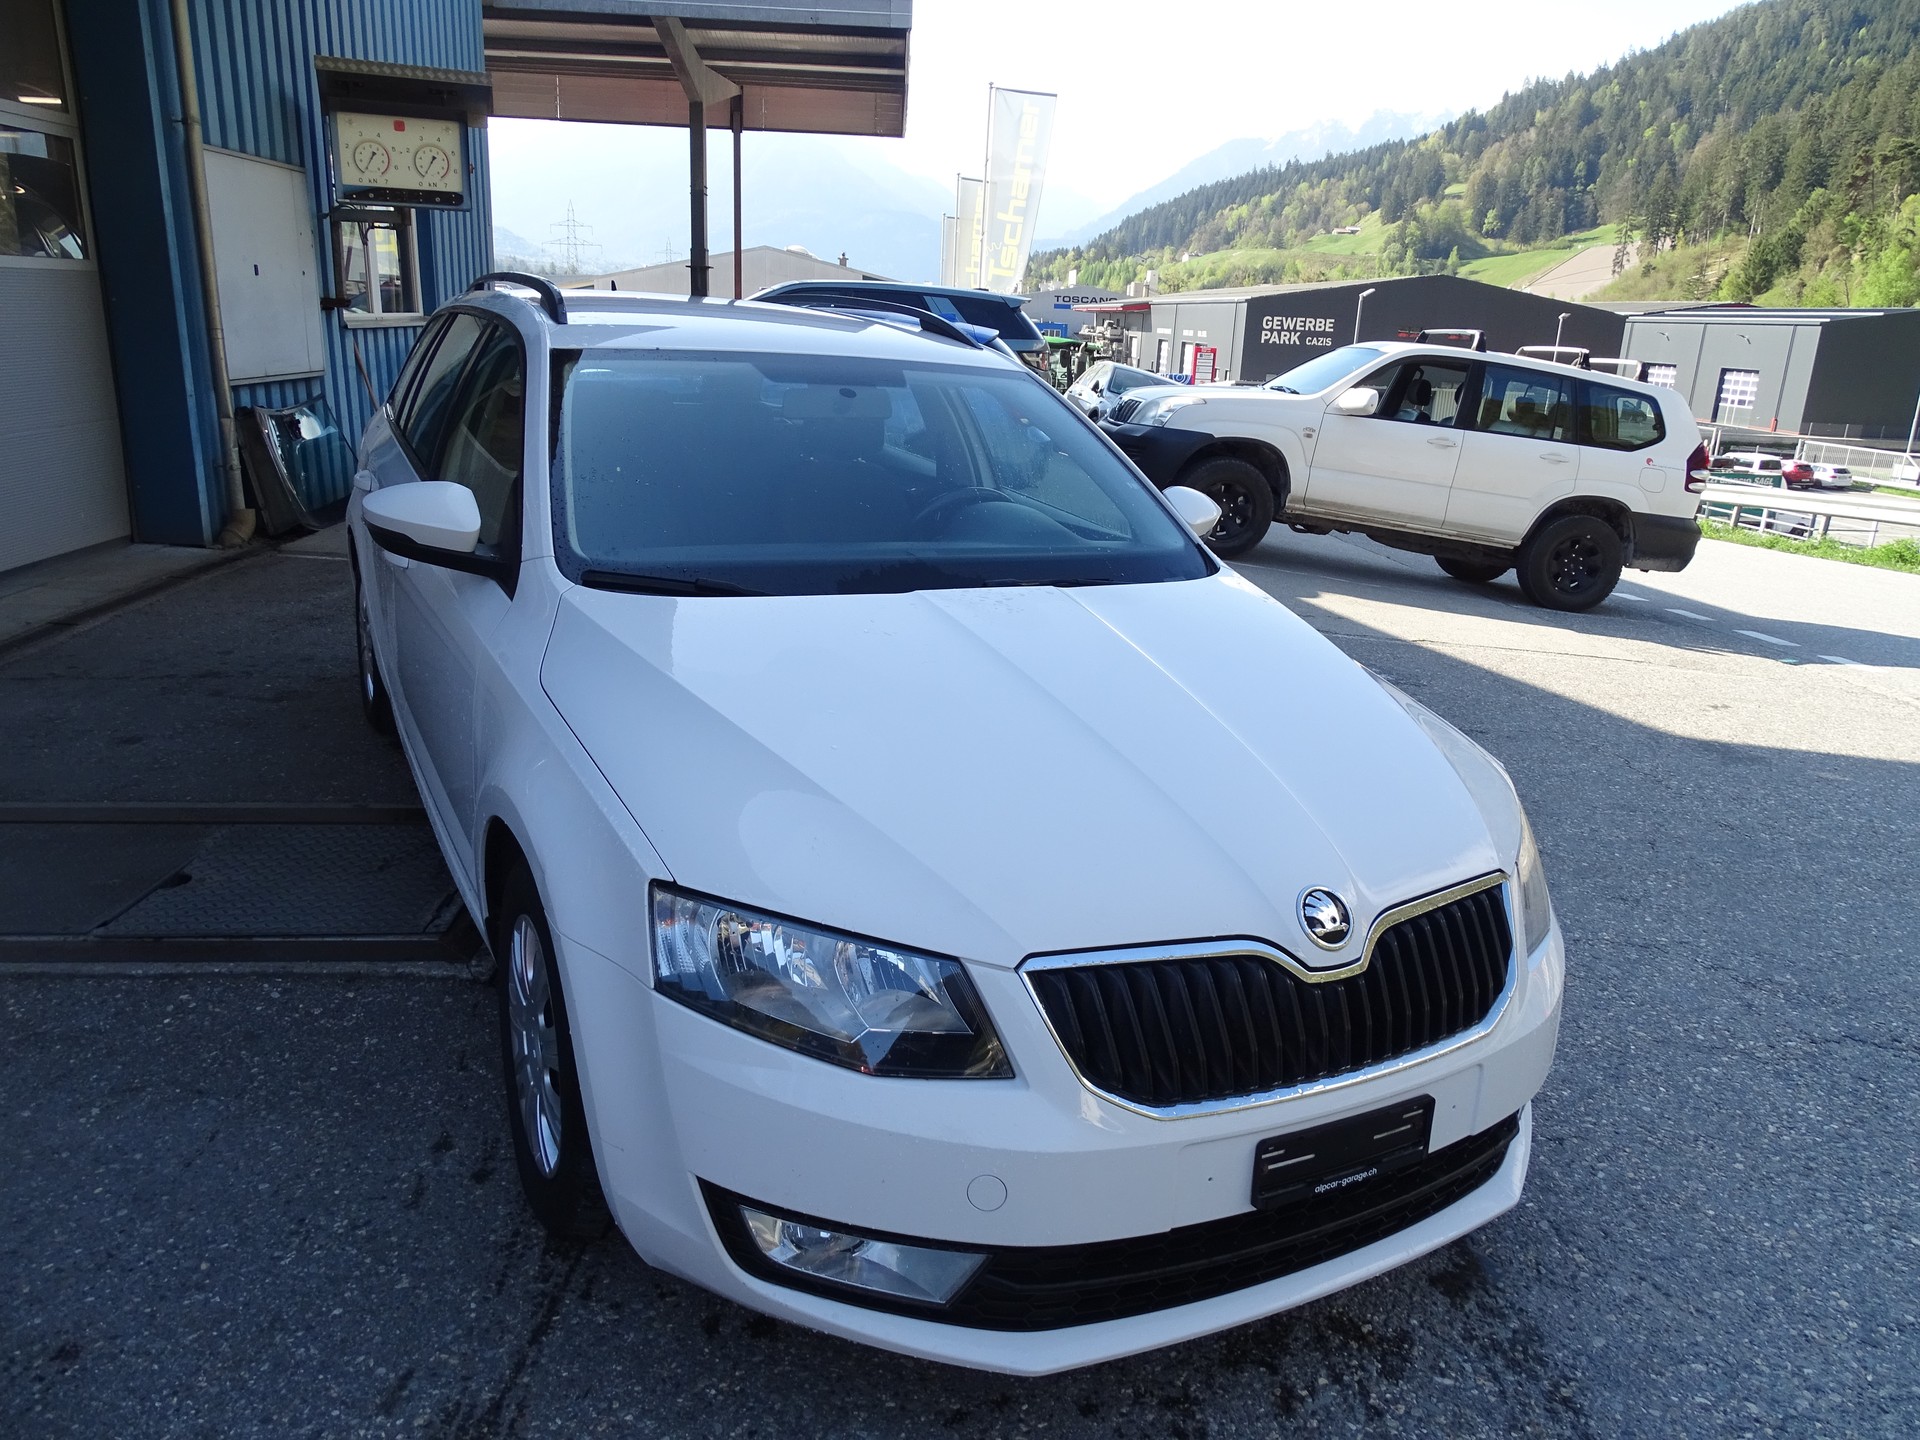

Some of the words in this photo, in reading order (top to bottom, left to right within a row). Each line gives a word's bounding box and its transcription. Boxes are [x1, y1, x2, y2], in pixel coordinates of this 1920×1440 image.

[1262, 316, 1335, 332] GEWERBE
[1260, 331, 1301, 345] PARK
[1306, 337, 1332, 346] CAZIS
[1754, 477, 1774, 485] SAGL
[1314, 1167, 1378, 1193] alpcar-garage.ch
